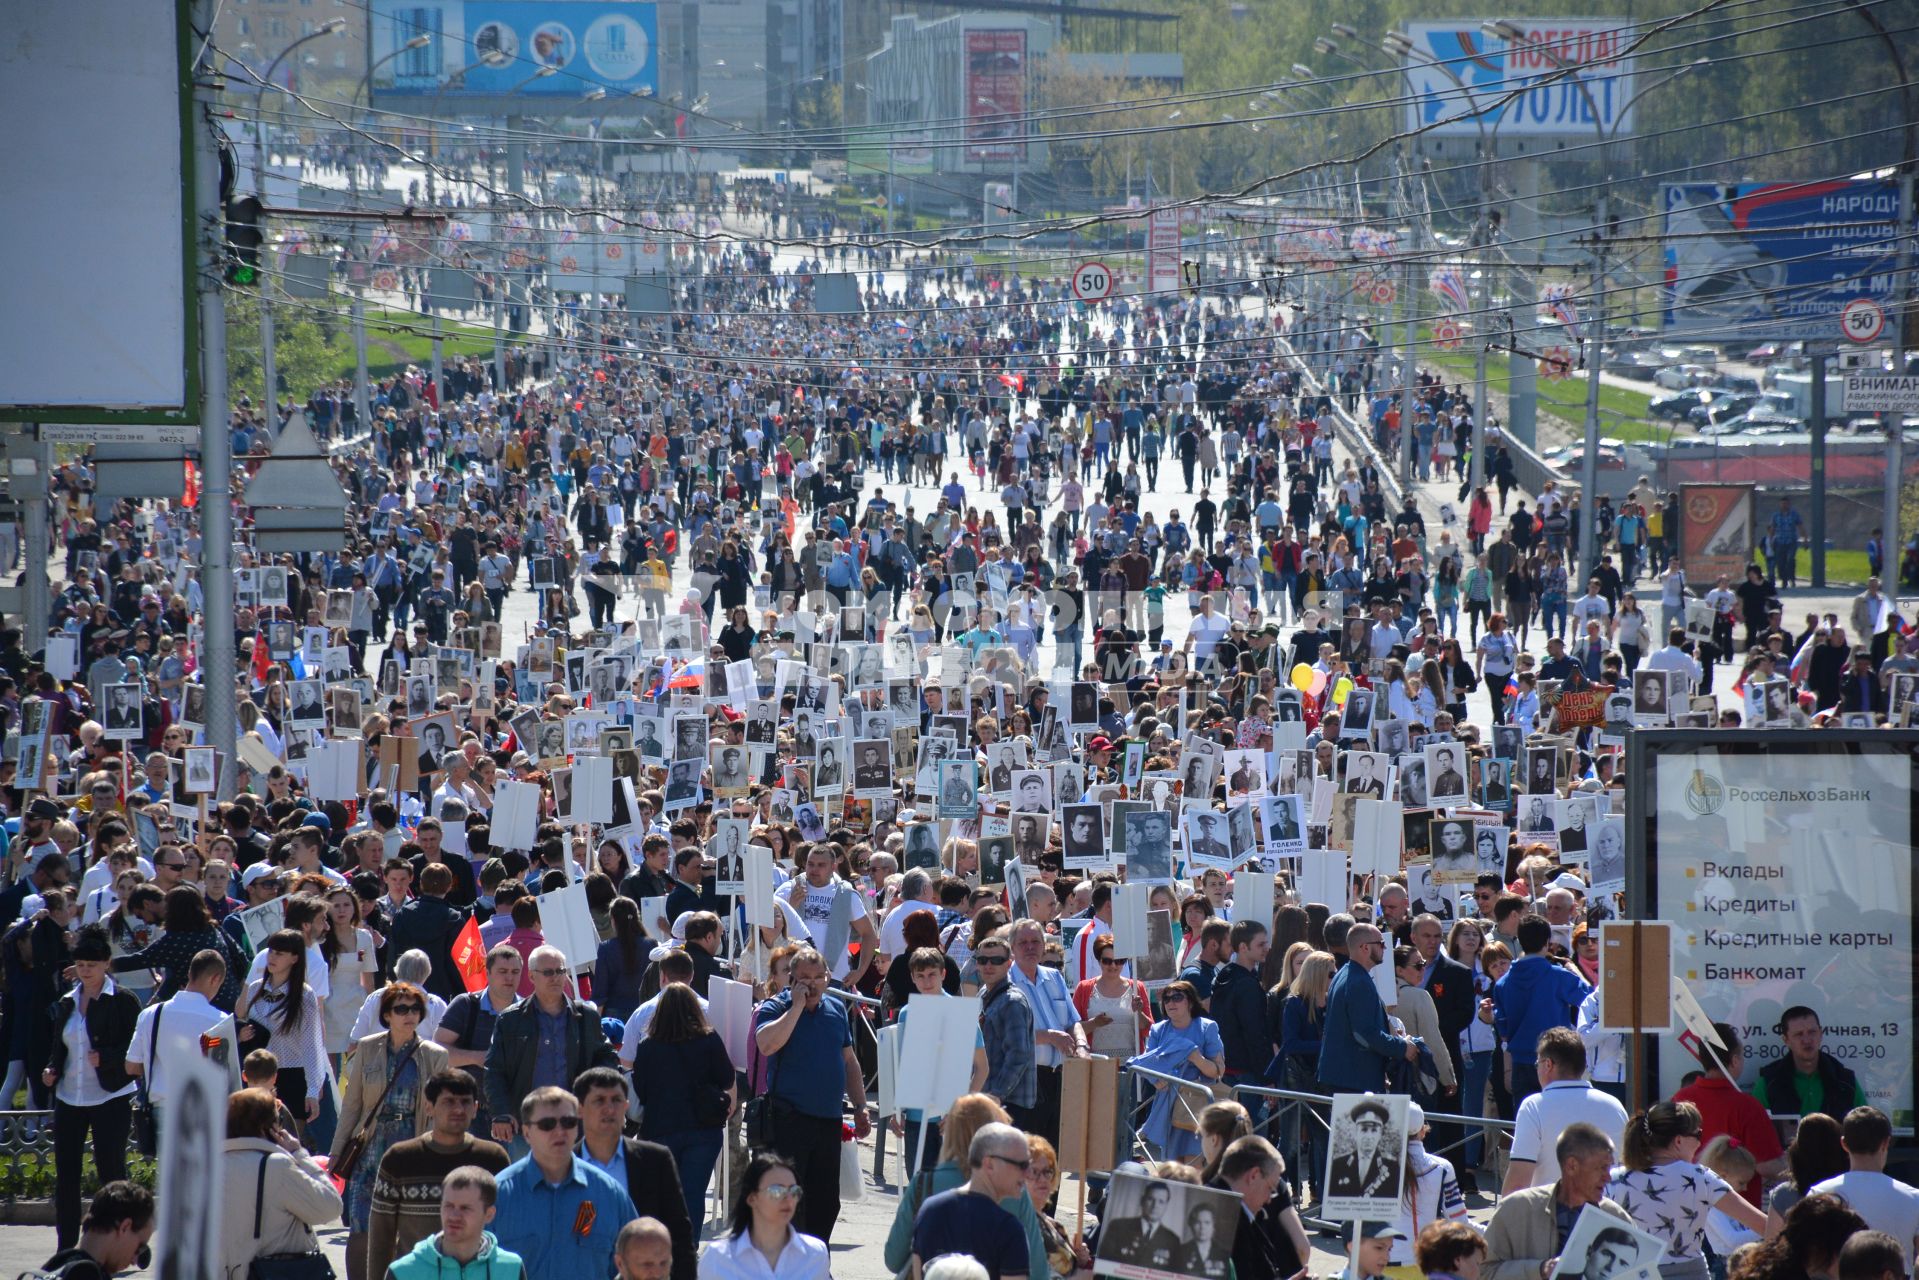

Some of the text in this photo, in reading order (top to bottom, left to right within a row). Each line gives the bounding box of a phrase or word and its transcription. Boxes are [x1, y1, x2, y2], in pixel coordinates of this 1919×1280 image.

[1510, 75, 1618, 124] 70 ЛЕТ
[1081, 274, 1105, 291] 50
[1851, 313, 1873, 330] 50
[1562, 691, 1594, 707] День
[1729, 787, 1871, 802] РоссельхозБанк
[1703, 862, 1784, 880] Вклады
[1704, 897, 1795, 915] Кредиты
[1705, 931, 1894, 949] Кредитные карты
[1705, 964, 1806, 980] Банкомат
[1742, 1026, 1767, 1039] ул.
[1881, 1023, 1899, 1036] 13
